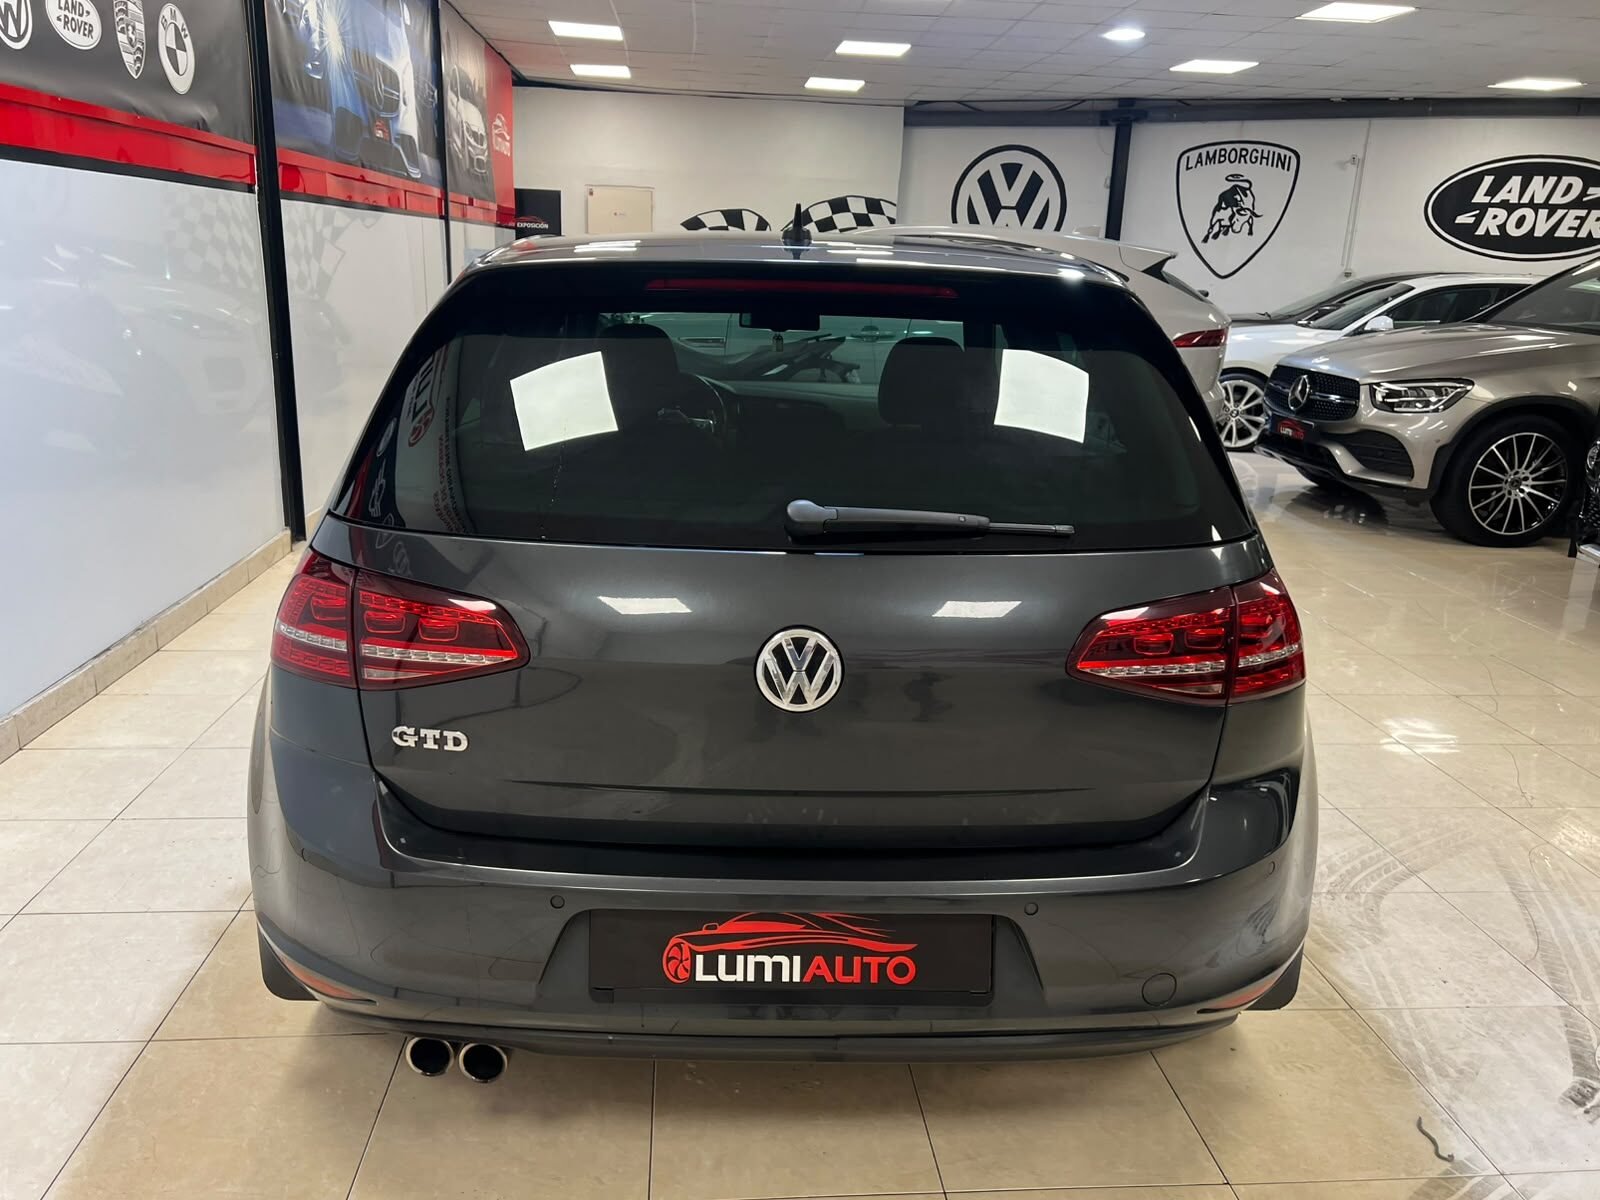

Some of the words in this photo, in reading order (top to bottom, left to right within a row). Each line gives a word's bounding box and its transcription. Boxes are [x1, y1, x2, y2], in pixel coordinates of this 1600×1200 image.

[57, 0, 85, 18] LAND
[63, 13, 94, 40] ROVER
[1185, 147, 1292, 172] LAMBORGHINI
[1471, 175, 1584, 205] LAND
[1474, 207, 1600, 239] ROVER
[391, 725, 469, 752] GTD
